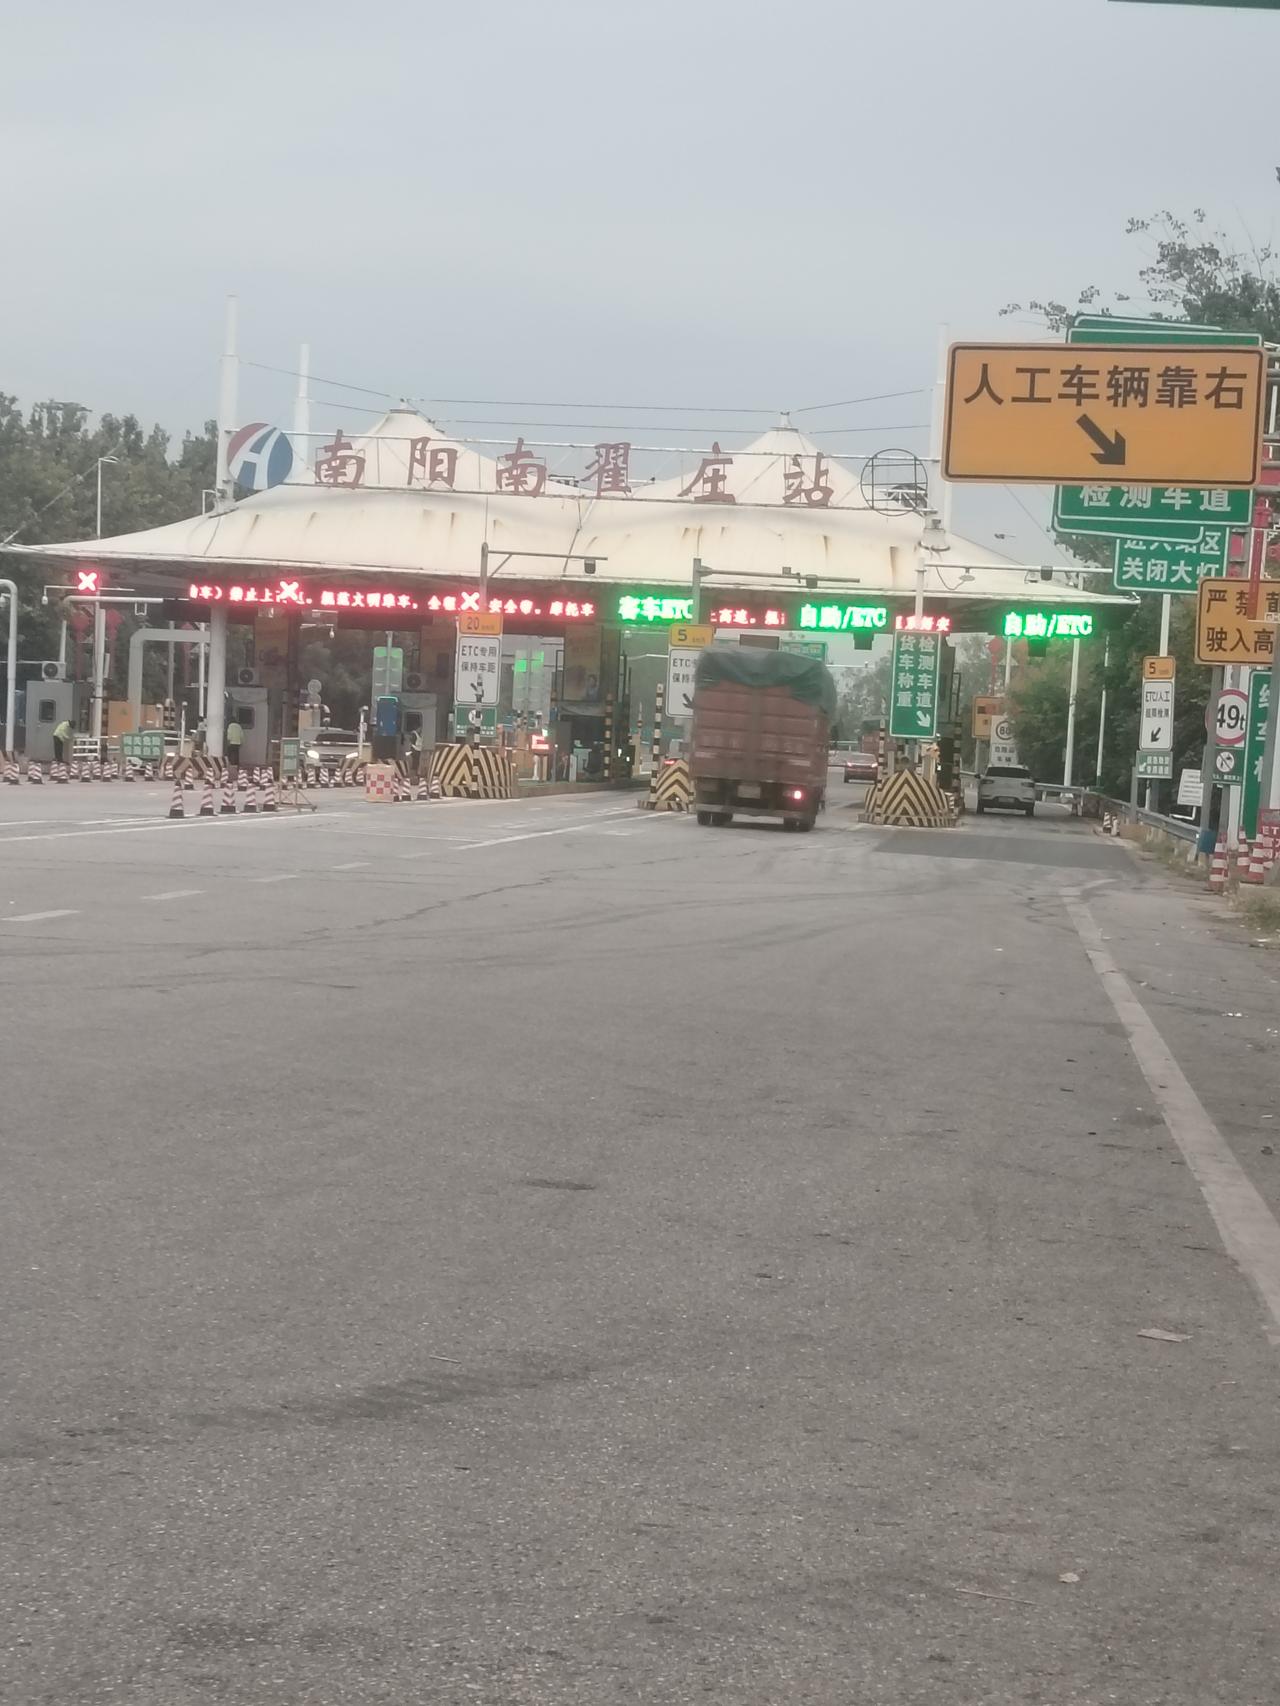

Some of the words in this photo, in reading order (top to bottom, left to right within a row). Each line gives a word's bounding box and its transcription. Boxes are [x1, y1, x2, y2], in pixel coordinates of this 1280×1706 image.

[964, 363, 1247, 409] 人工车辆靠右
[1080, 487, 1231, 513] 检测车道
[1122, 557, 1220, 584] 关闭大灯
[466, 616, 480, 631] 20
[800, 603, 887, 629] 自助/ETC
[1004, 611, 1092, 637] 自助/ETC
[677, 629, 688, 642] 5
[1206, 627, 1275, 655] 驶入高
[461, 645, 497, 657] ETC专用
[461, 662, 497, 673] 保持车距
[896, 636, 916, 707] 货车称重
[916, 636, 935, 708] 检测车道
[1149, 662, 1156, 674] 5
[1216, 703, 1246, 731] 49t
